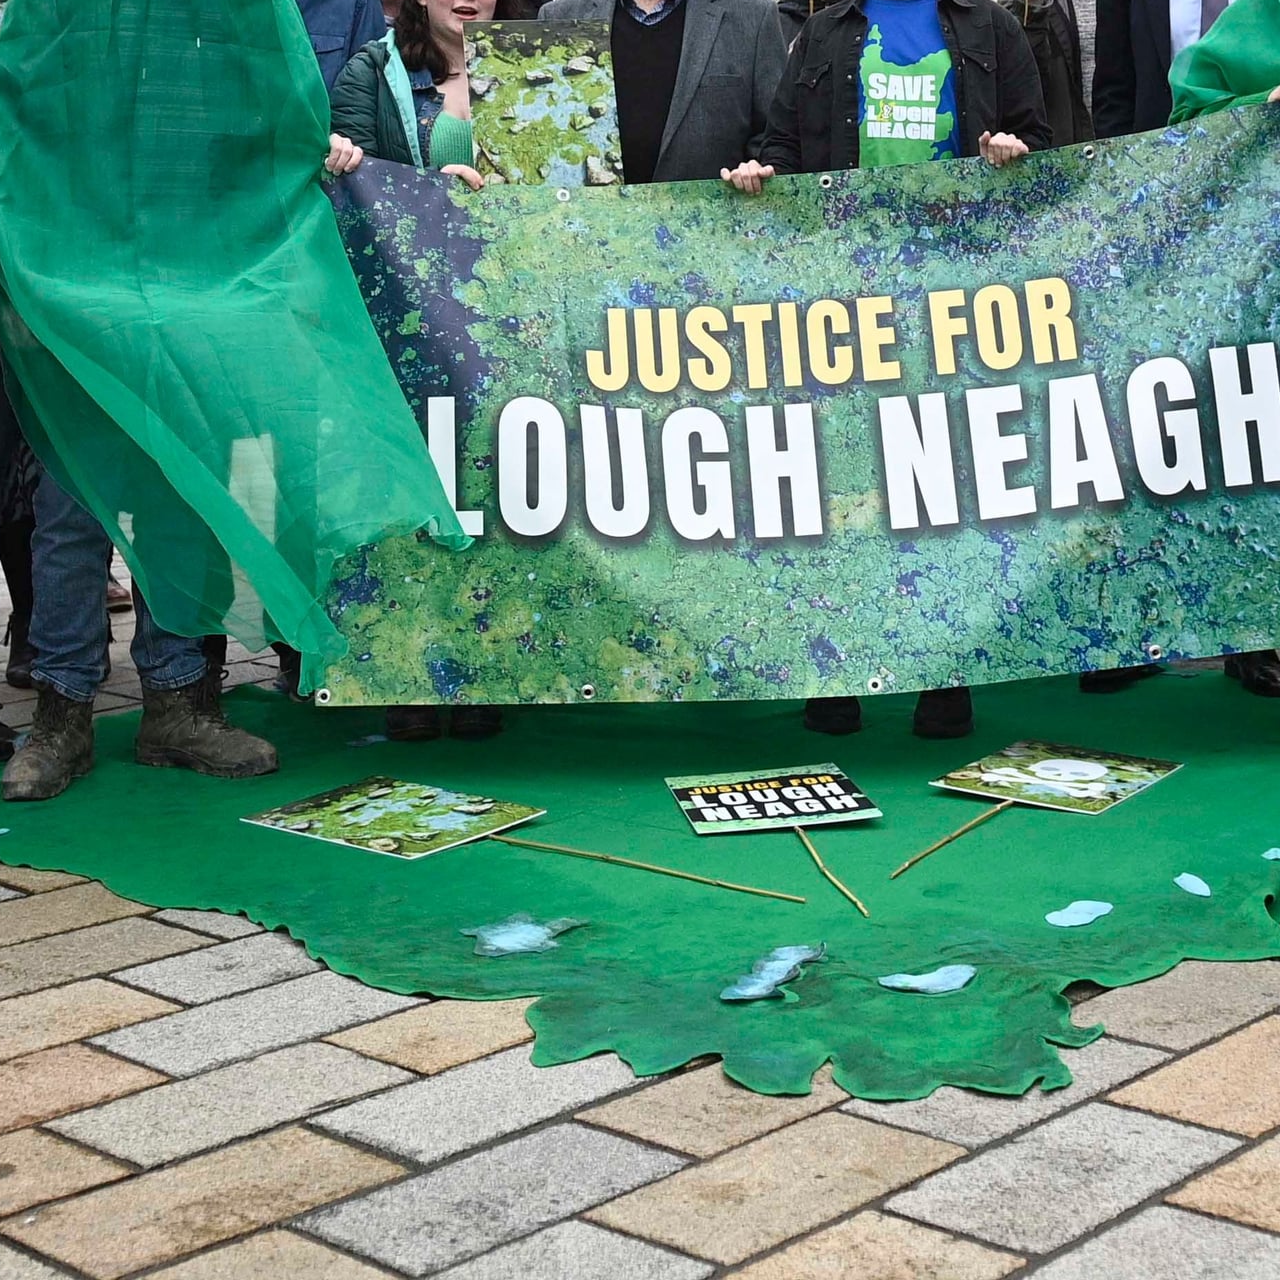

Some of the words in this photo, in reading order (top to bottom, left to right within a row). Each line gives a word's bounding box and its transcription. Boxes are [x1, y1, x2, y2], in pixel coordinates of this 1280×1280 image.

[868, 72, 936, 102] SAVE
[867, 121, 936, 141] NEAGH
[585, 296, 902, 393] JUSTICE
[928, 277, 1078, 376] FOR
[427, 395, 824, 541] LOUGH
[688, 780, 783, 796] JUSTICE
[789, 775, 836, 787] FOR
[690, 782, 845, 809] LOUGH
[700, 794, 860, 822] NEAGH
